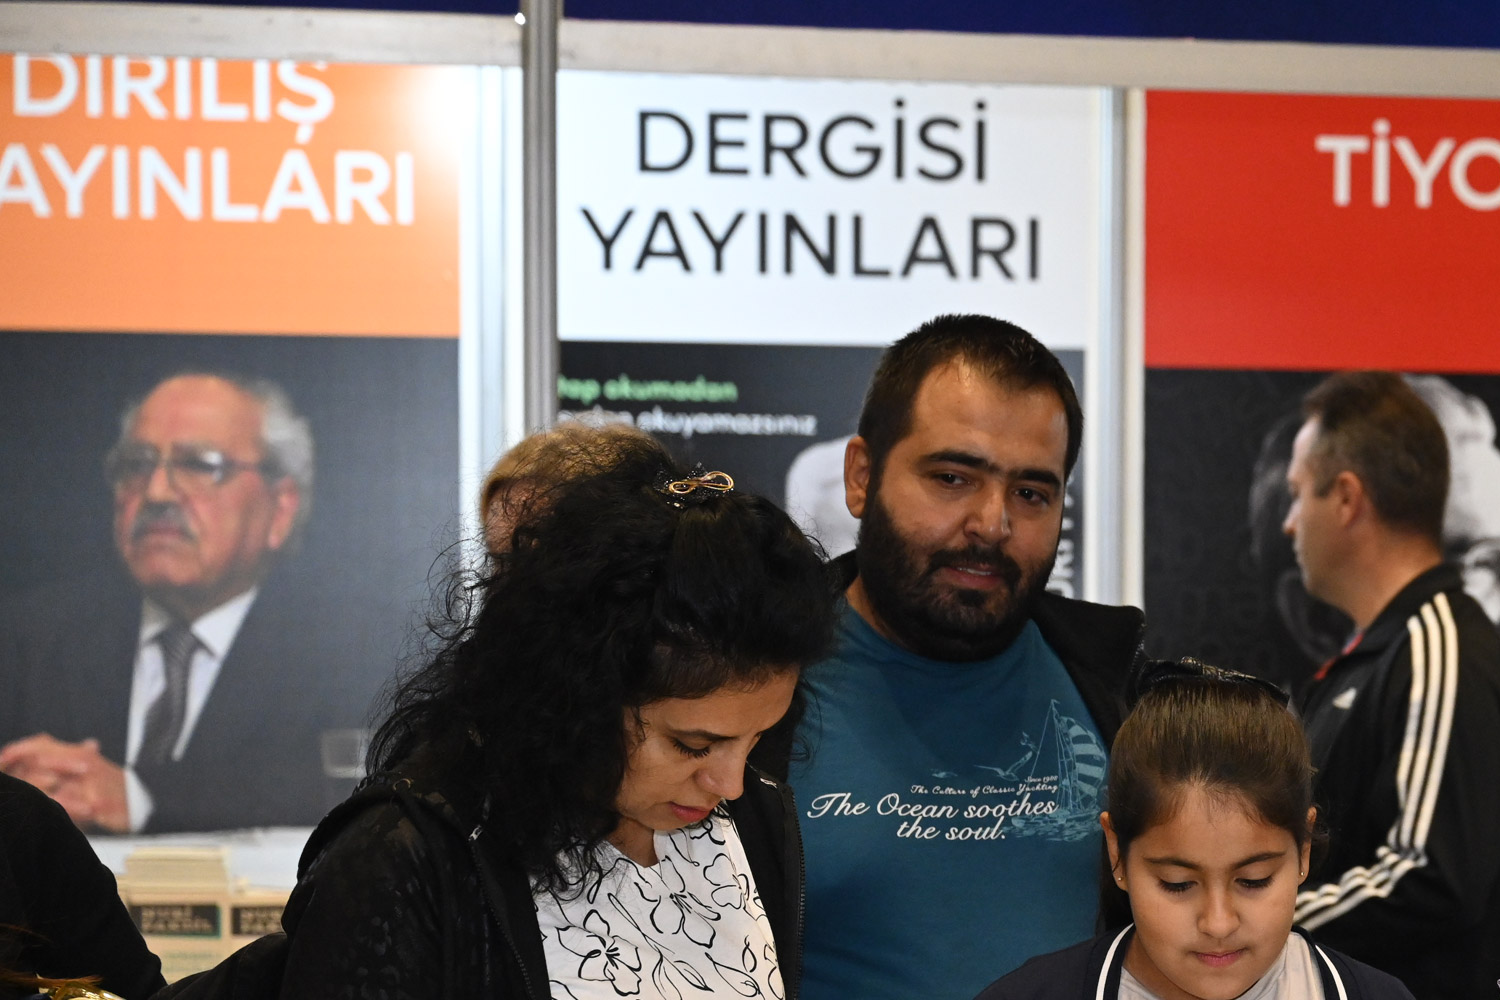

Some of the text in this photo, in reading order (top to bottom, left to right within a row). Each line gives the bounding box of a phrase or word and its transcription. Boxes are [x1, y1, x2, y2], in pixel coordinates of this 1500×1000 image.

[637, 95, 988, 183] DERGİSİ
[580, 207, 1040, 282] YAYINLARI
[806, 792, 1060, 818] The Ocean soothes
[896, 815, 1007, 841] the soul.
